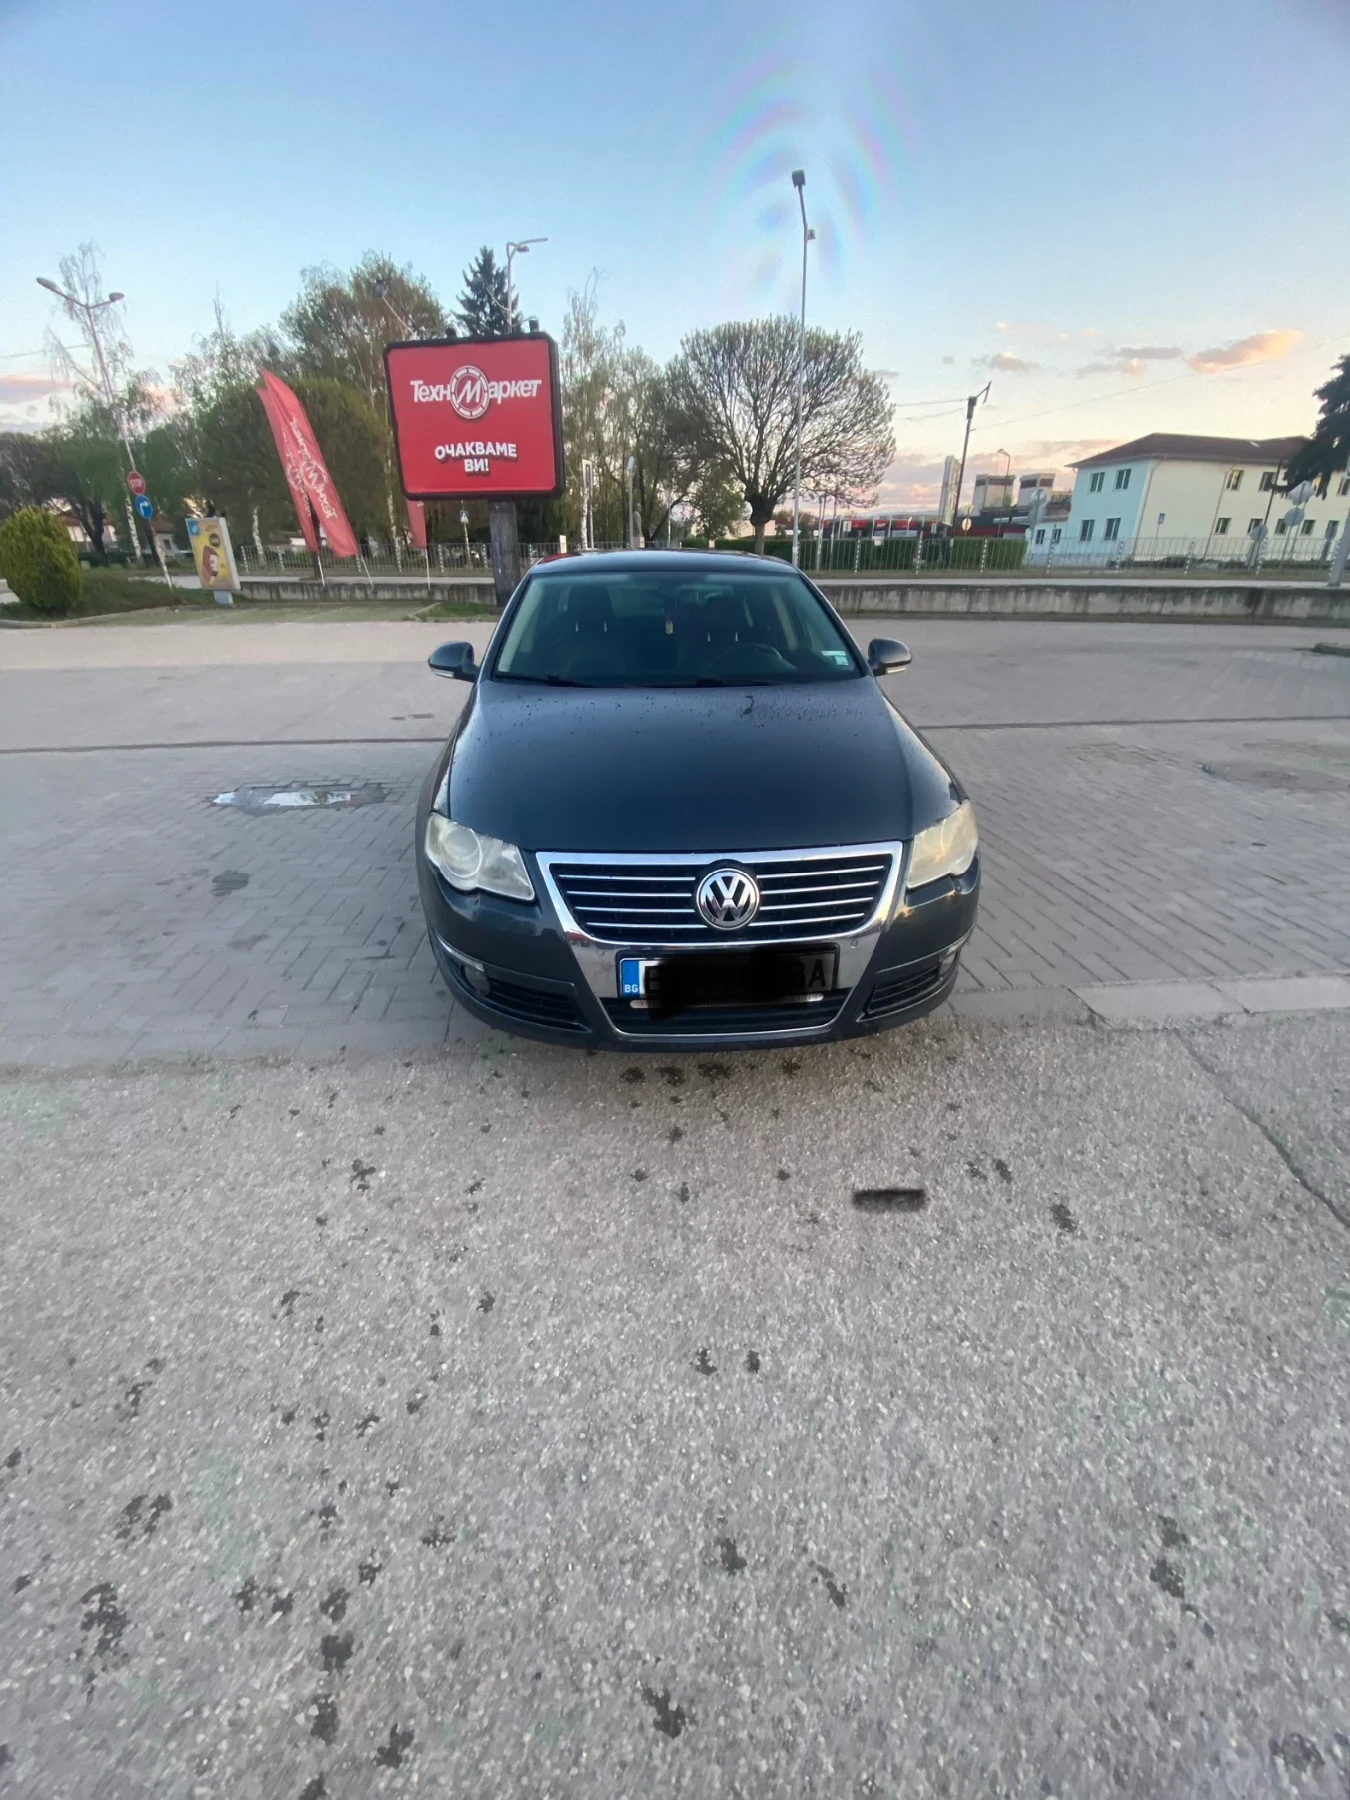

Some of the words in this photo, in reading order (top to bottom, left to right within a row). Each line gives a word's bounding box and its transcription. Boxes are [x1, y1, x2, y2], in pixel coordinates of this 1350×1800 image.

[435, 441, 518, 460] ОЧАКВАМЕ
[464, 458, 489, 473] ВИ!
[129, 478, 143, 489] STOP
[702, 872, 754, 925] VW
[624, 983, 639, 993] BG
